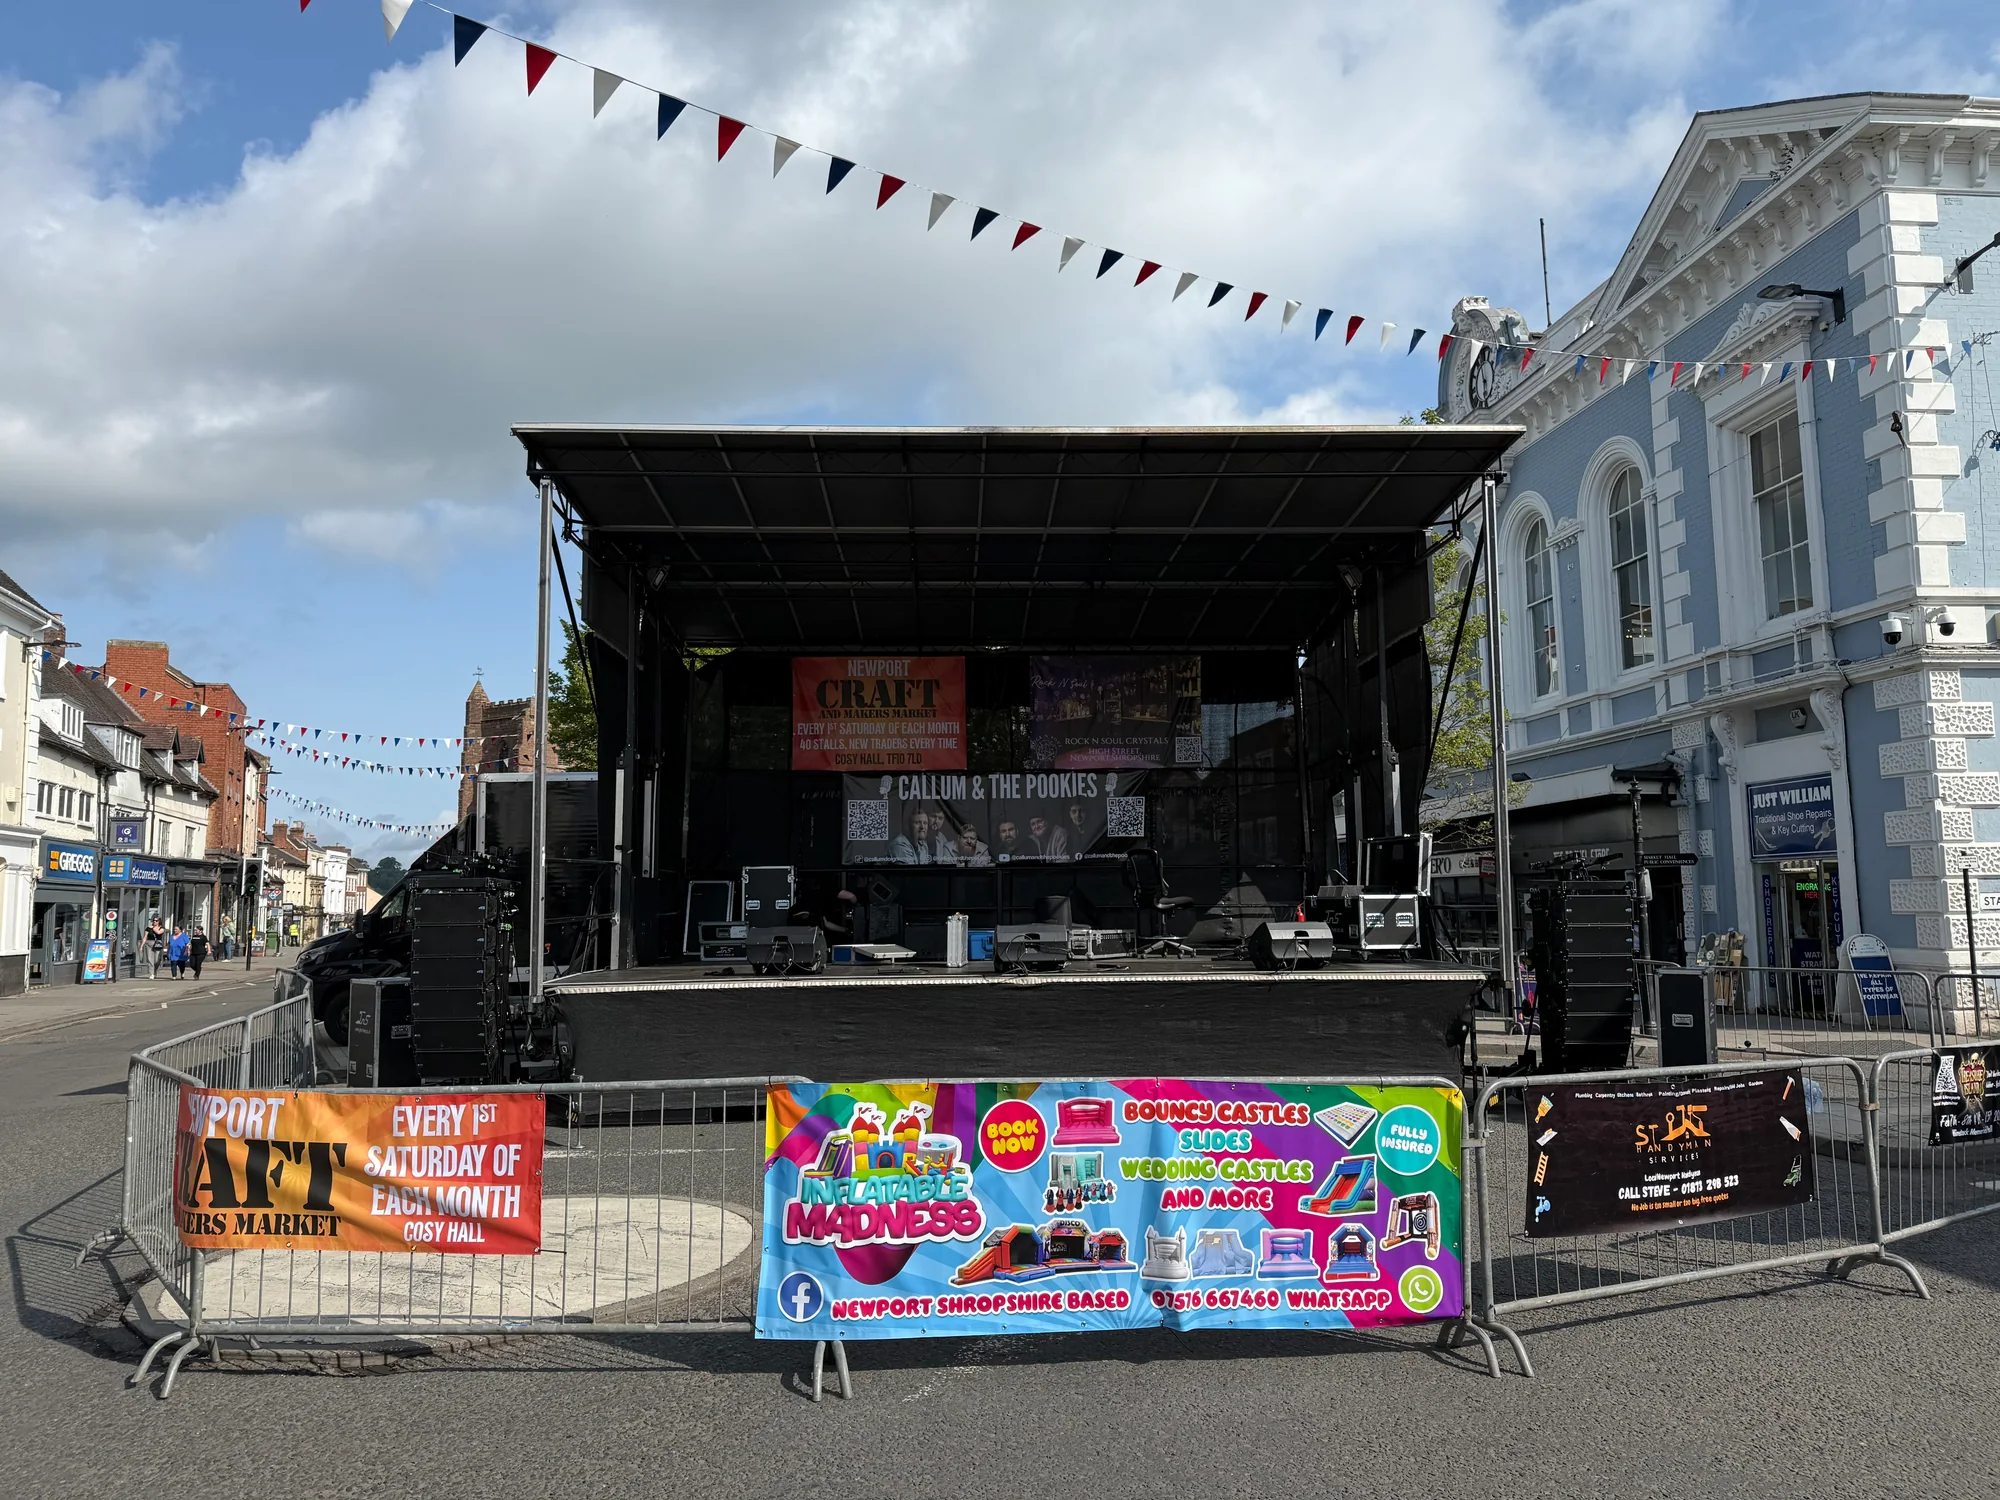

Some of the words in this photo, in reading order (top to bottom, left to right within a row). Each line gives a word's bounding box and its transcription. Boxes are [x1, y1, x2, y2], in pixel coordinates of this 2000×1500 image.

[847, 659, 911, 677] NEWPORT
[1031, 675, 1056, 689] Rock
[816, 678, 941, 709] CRAFT
[818, 709, 841, 719] AND
[843, 708, 890, 719] MAKERS
[892, 708, 938, 719] MARKET
[797, 722, 825, 736] EVERY
[839, 722, 887, 735] SATURDAY
[888, 722, 900, 735] OF
[901, 722, 926, 735] EACH
[928, 721, 960, 735] MONTH
[800, 738, 811, 751] 40
[849, 738, 870, 750] NEW
[871, 737, 908, 750] TRADERS
[910, 737, 936, 750] EVERY
[937, 737, 958, 749] TIME
[1065, 737, 1090, 745] ROCK
[1091, 737, 1099, 745] N
[1101, 737, 1124, 745] SOUL
[1125, 736, 1169, 745] CRYSTALS
[1088, 747, 1110, 755] HIGH
[835, 753, 858, 766] COSY
[886, 752, 905, 765] TF10
[907, 752, 922, 765] 7LD
[1070, 754, 1110, 762] NEWPORT
[1110, 754, 1161, 762] SHROPSHIRE
[898, 774, 967, 800] CALLUM
[972, 776, 985, 800] &
[988, 773, 1022, 799] THE
[1028, 772, 1097, 799] POOKIES
[1753, 791, 1778, 809] JUST
[1779, 785, 1831, 806] WILLIAM
[1755, 813, 1786, 824] Traditional
[1786, 811, 1804, 821] Shoe
[1805, 808, 1832, 821] Repairs
[1771, 826, 1776, 835] &
[1777, 825, 1790, 836] Key
[1791, 823, 1815, 835] Cutting
[60, 851, 94, 874] GREGGS
[1796, 882, 1832, 892] ENGRANG
[1804, 891, 1819, 899] HER
[1831, 876, 1839, 909] KEY
[392, 1103, 467, 1138] EVERY
[472, 1103, 498, 1137] 1ST
[1123, 1100, 1212, 1125] BOUNCY
[1216, 1101, 1311, 1126] CASTLES
[986, 1118, 1039, 1139] BOOK
[1390, 1123, 1428, 1140] FULLY
[991, 1135, 1037, 1156] NOW
[1179, 1130, 1252, 1152] SLIDES
[1381, 1137, 1434, 1155] INSURED
[1636, 1139, 1712, 1154] HANDYMAN
[363, 1144, 489, 1178] SATURDAY
[493, 1143, 522, 1177] OF
[1648, 1152, 1700, 1165] SERVICES
[1120, 1158, 1216, 1181] WEDDING
[1219, 1159, 1313, 1183] CASTLES
[1656, 1171, 1681, 1182] Newport
[800, 1175, 969, 1206] INFLATABLE
[1618, 1186, 1640, 1200] CALL
[1642, 1184, 1671, 1198] STEVE
[1706, 1177, 1722, 1191] 298
[1724, 1174, 1739, 1188] 523
[370, 1185, 431, 1218] EACH
[437, 1184, 521, 1219] MONTH
[1161, 1188, 1205, 1211] AND
[1208, 1188, 1273, 1211] MORE
[1662, 1200, 1677, 1209] small
[1677, 1200, 1683, 1208] or
[1713, 1192, 1729, 1203] quotes
[232, 1213, 342, 1238] MARKET
[786, 1200, 982, 1243] MADNESS
[1059, 1219, 1081, 1228] DISCO
[403, 1221, 446, 1244] COSY
[446, 1222, 486, 1243] HALL
[831, 1297, 935, 1320] NEWPORT
[937, 1291, 1063, 1315] SHROPSHIRE
[1067, 1290, 1130, 1311] BASED
[1204, 1289, 1280, 1309] 667460
[1286, 1290, 1391, 1311] WHATSAPP
